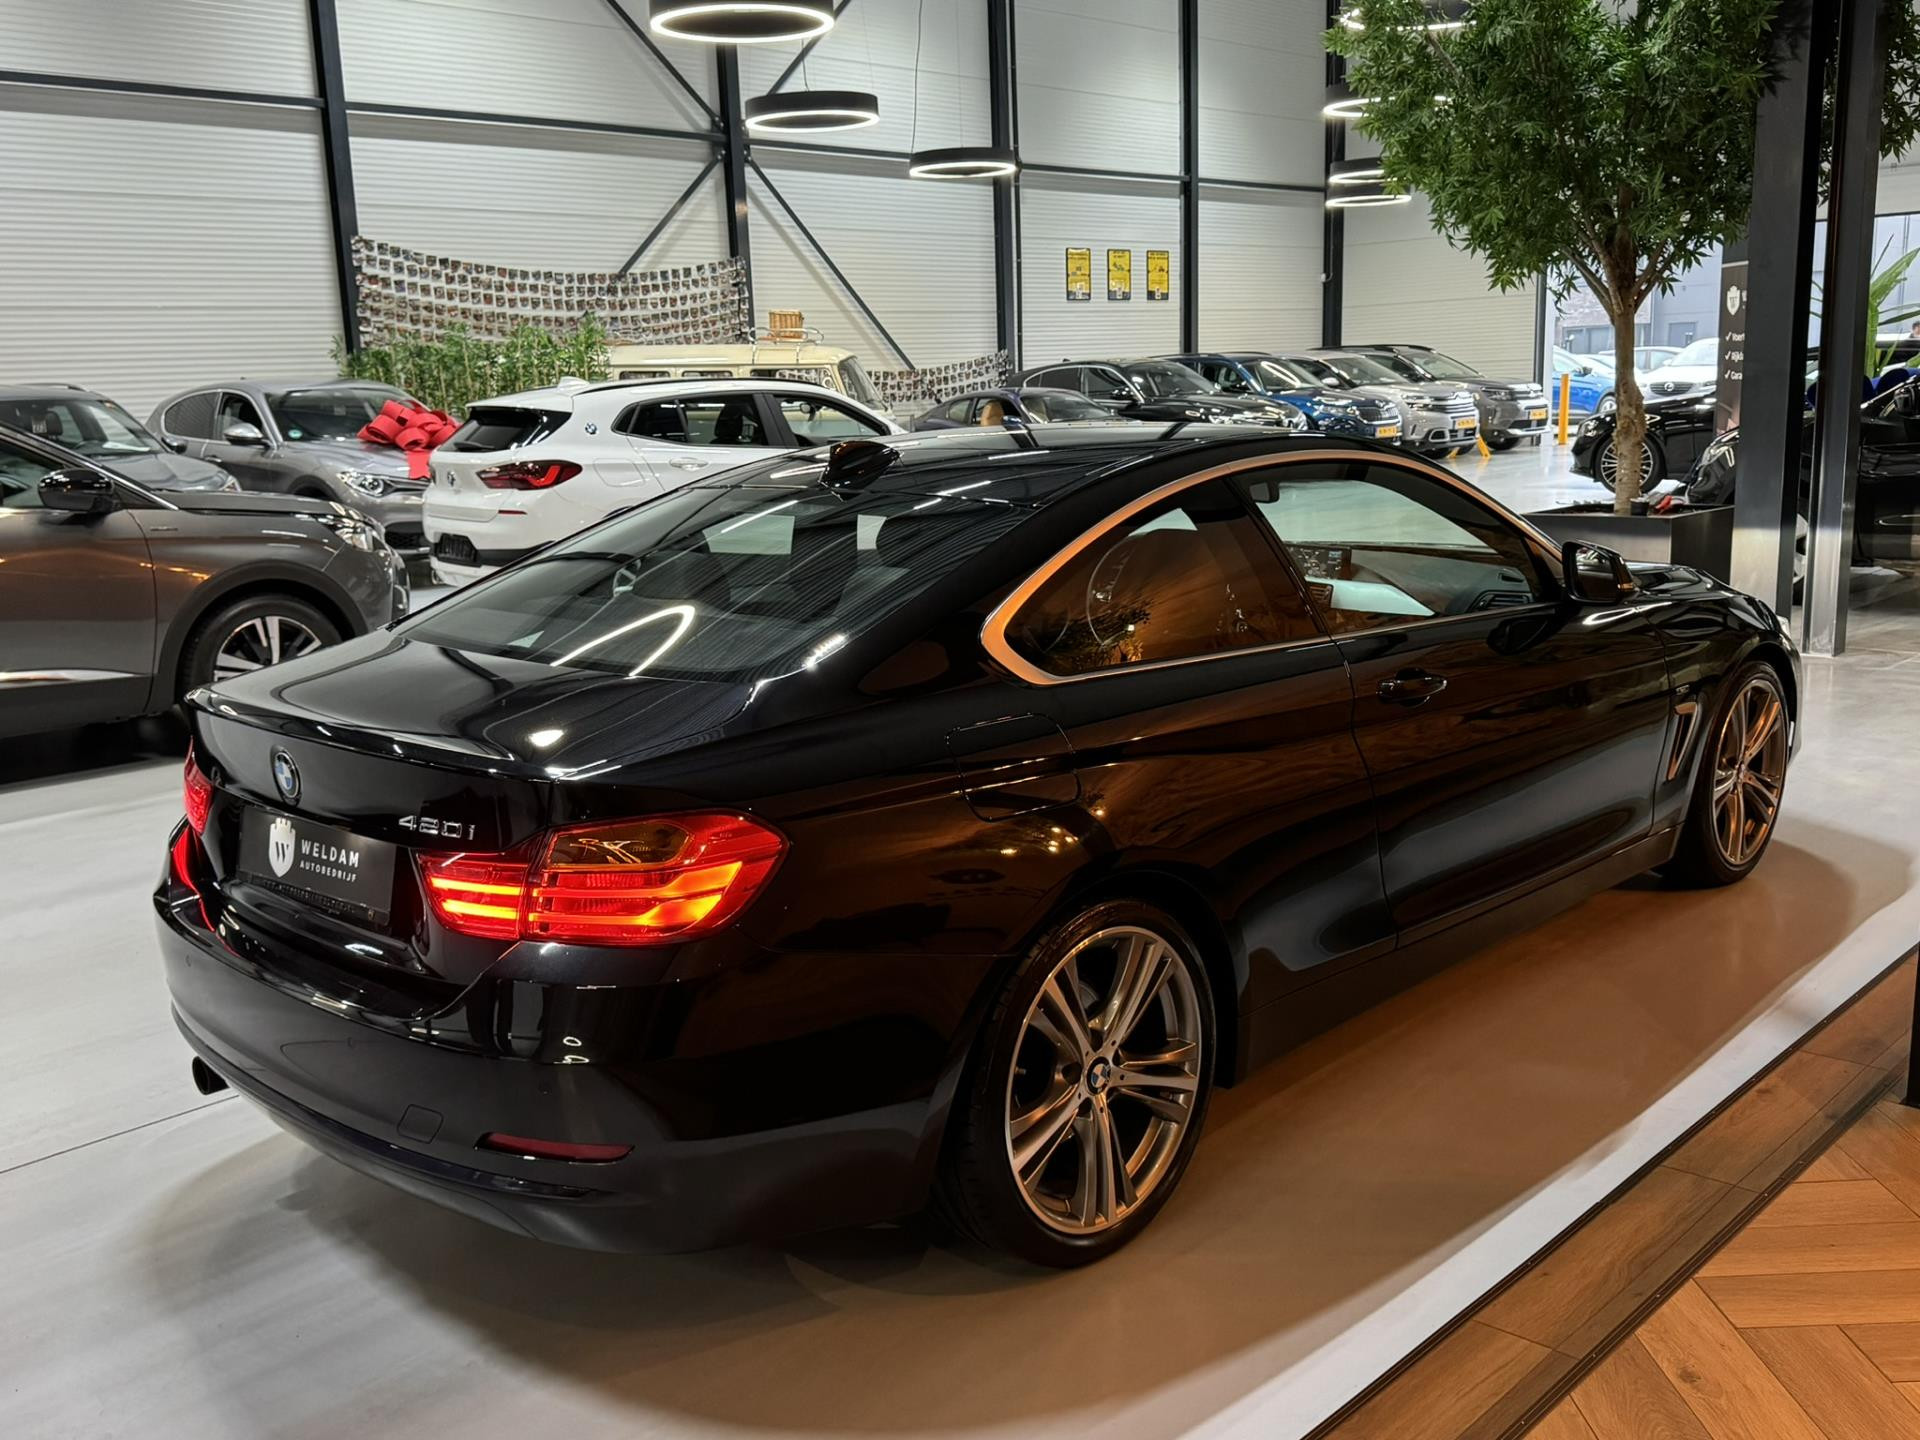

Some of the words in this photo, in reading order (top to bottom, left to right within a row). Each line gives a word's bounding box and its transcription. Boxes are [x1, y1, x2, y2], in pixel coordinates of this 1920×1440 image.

[398, 814, 476, 841] 420i
[301, 839, 359, 868] WELDAM
[300, 860, 357, 882] AUTOBEDRIJF
